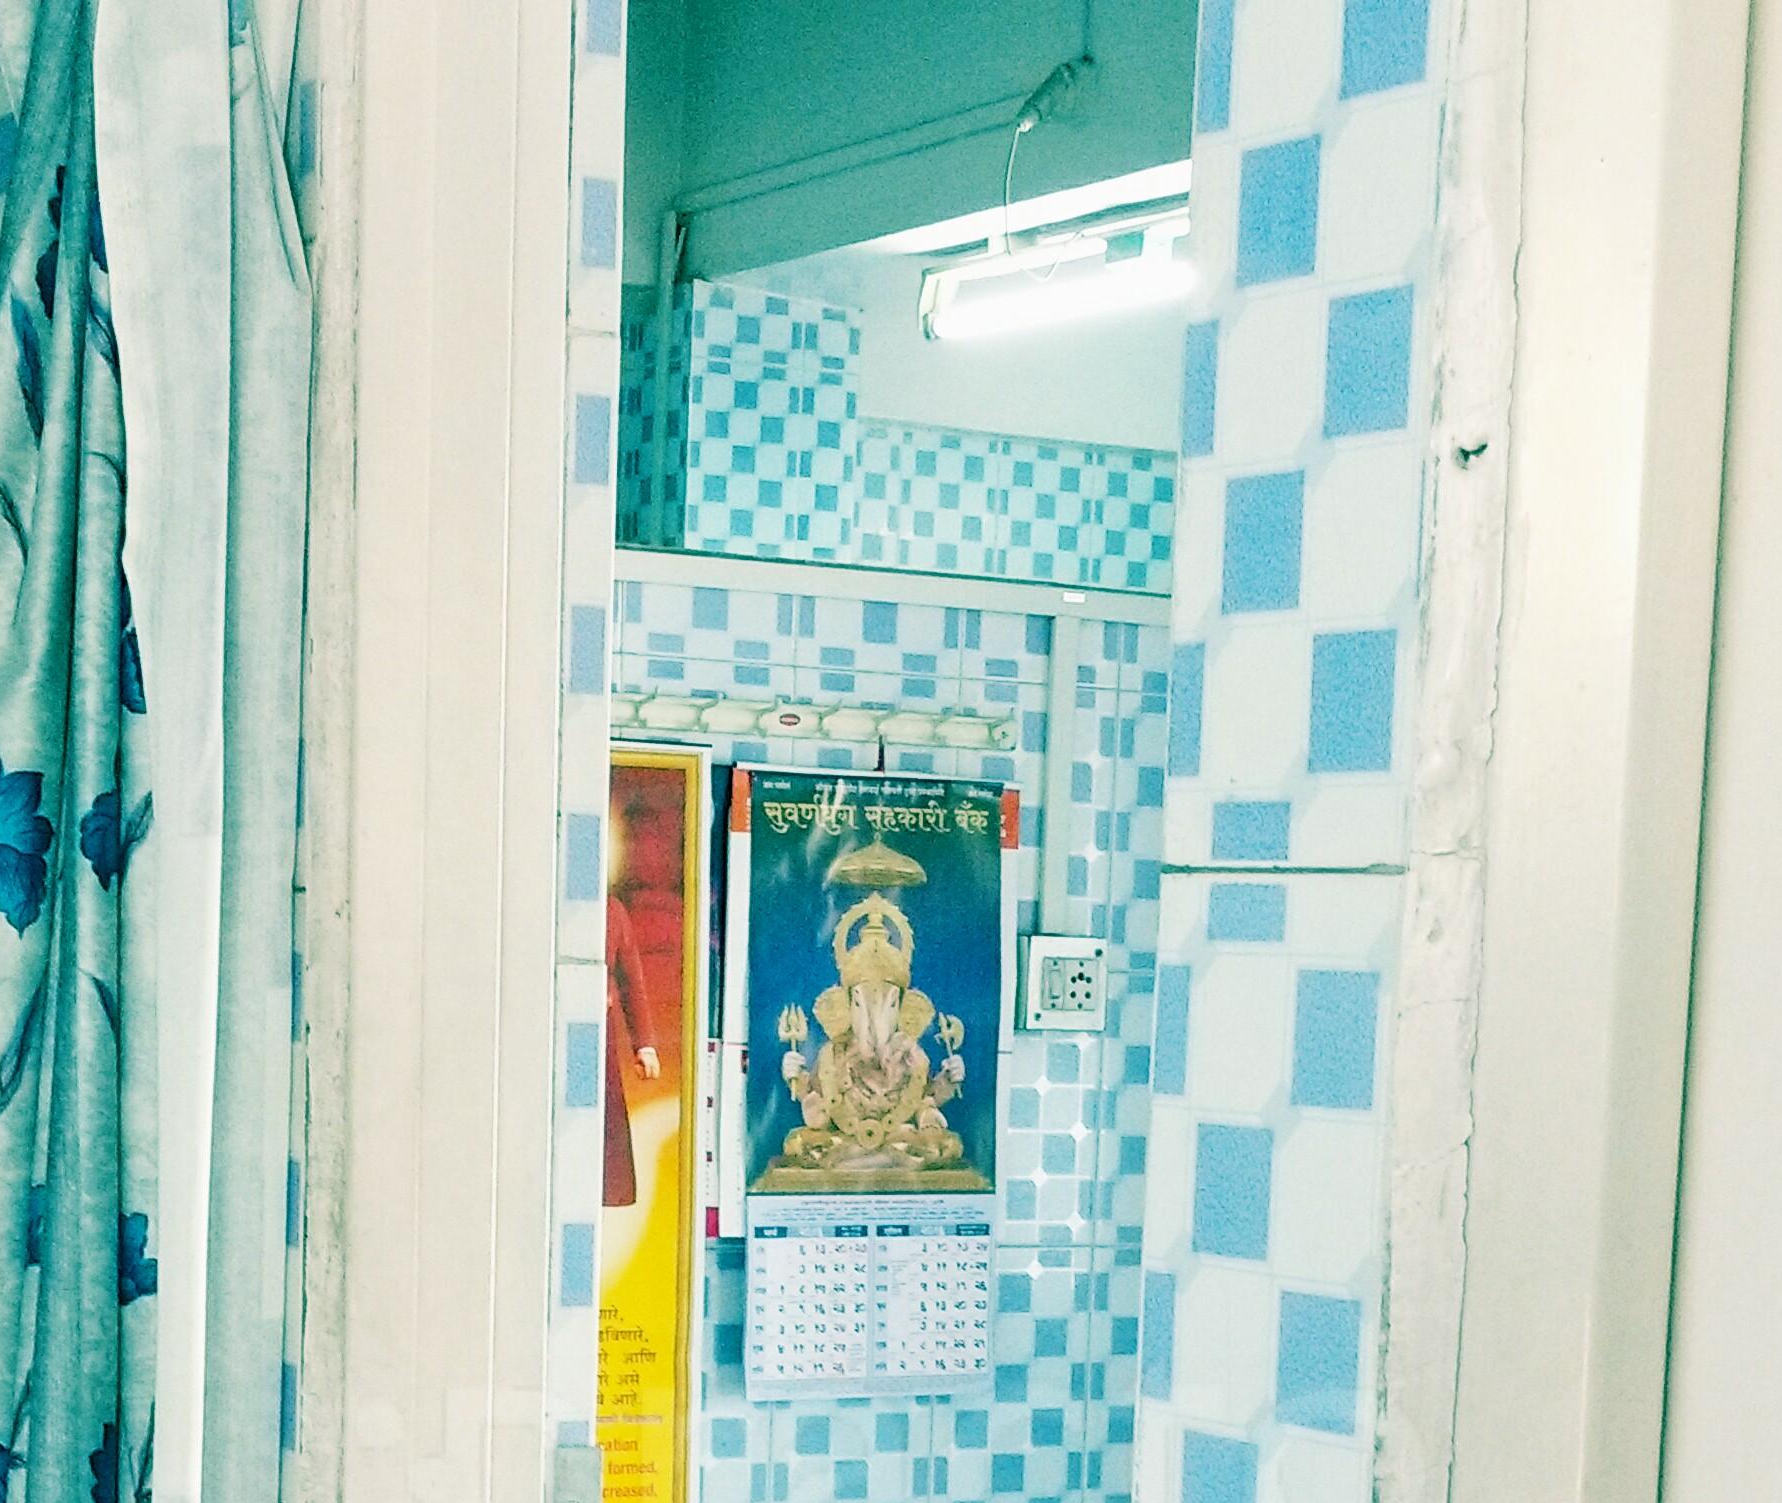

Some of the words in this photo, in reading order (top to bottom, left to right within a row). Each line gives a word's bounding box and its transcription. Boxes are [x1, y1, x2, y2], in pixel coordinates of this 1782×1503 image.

[864, 799, 950, 832] सहकारी
[954, 799, 989, 834] बँक
[603, 1482, 658, 1498] creased,
